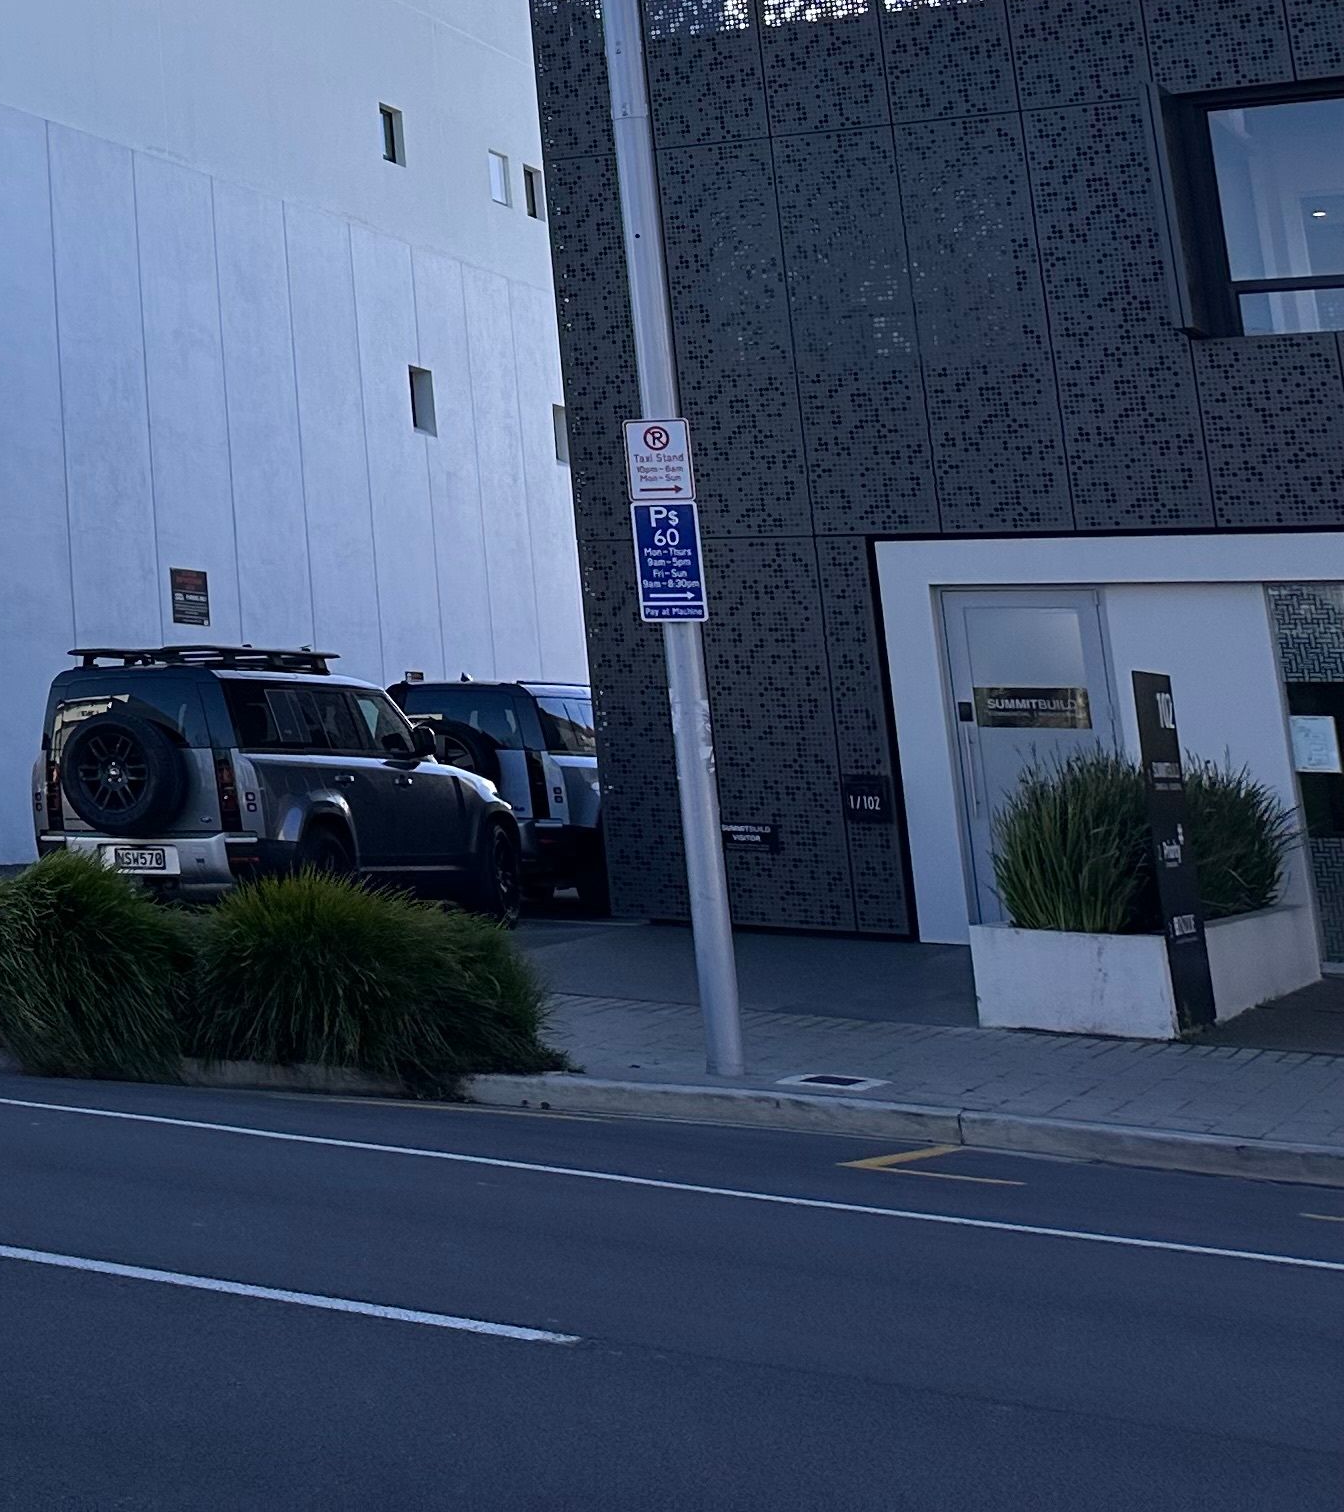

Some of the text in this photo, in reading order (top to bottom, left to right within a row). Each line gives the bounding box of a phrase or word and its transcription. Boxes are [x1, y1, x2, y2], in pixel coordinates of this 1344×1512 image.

[633, 453, 684, 463] Taxi Stand
[654, 528, 680, 546] 60
[645, 607, 659, 617] Pay
[672, 607, 703, 616] Machine
[987, 698, 1077, 710] SUMMITBUILD
[1156, 692, 1175, 729] 102
[117, 851, 163, 866] NSW570
